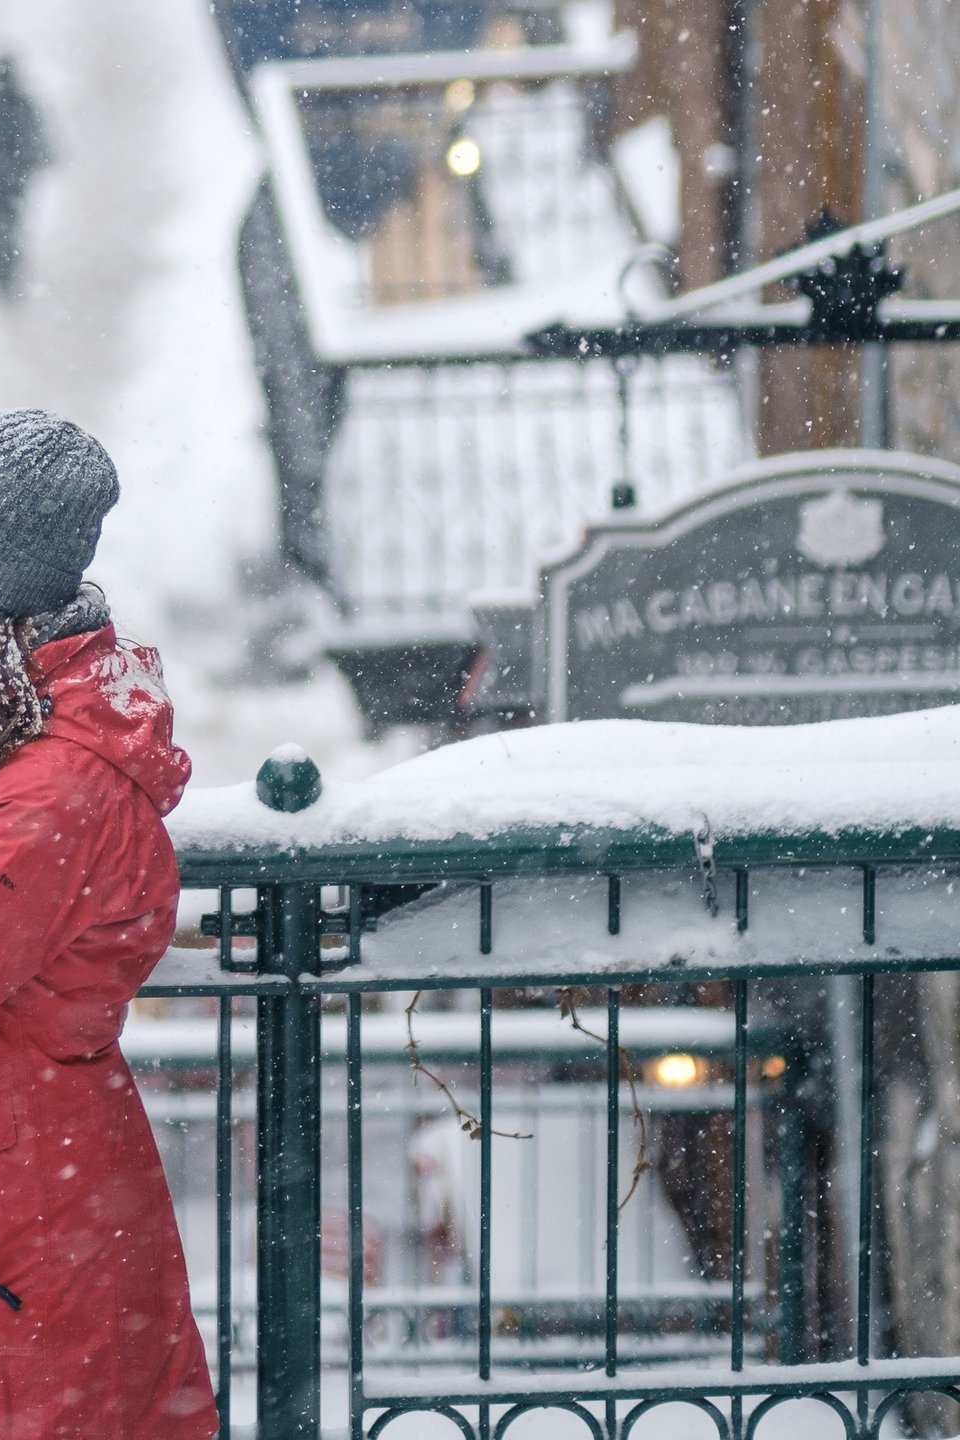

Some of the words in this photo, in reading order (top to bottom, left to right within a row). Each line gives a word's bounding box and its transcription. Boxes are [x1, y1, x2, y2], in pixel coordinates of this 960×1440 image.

[574, 597, 644, 651] MA
[645, 572, 825, 633] CABANE
[829, 570, 888, 617] EN
[891, 572, 960, 618] GA
